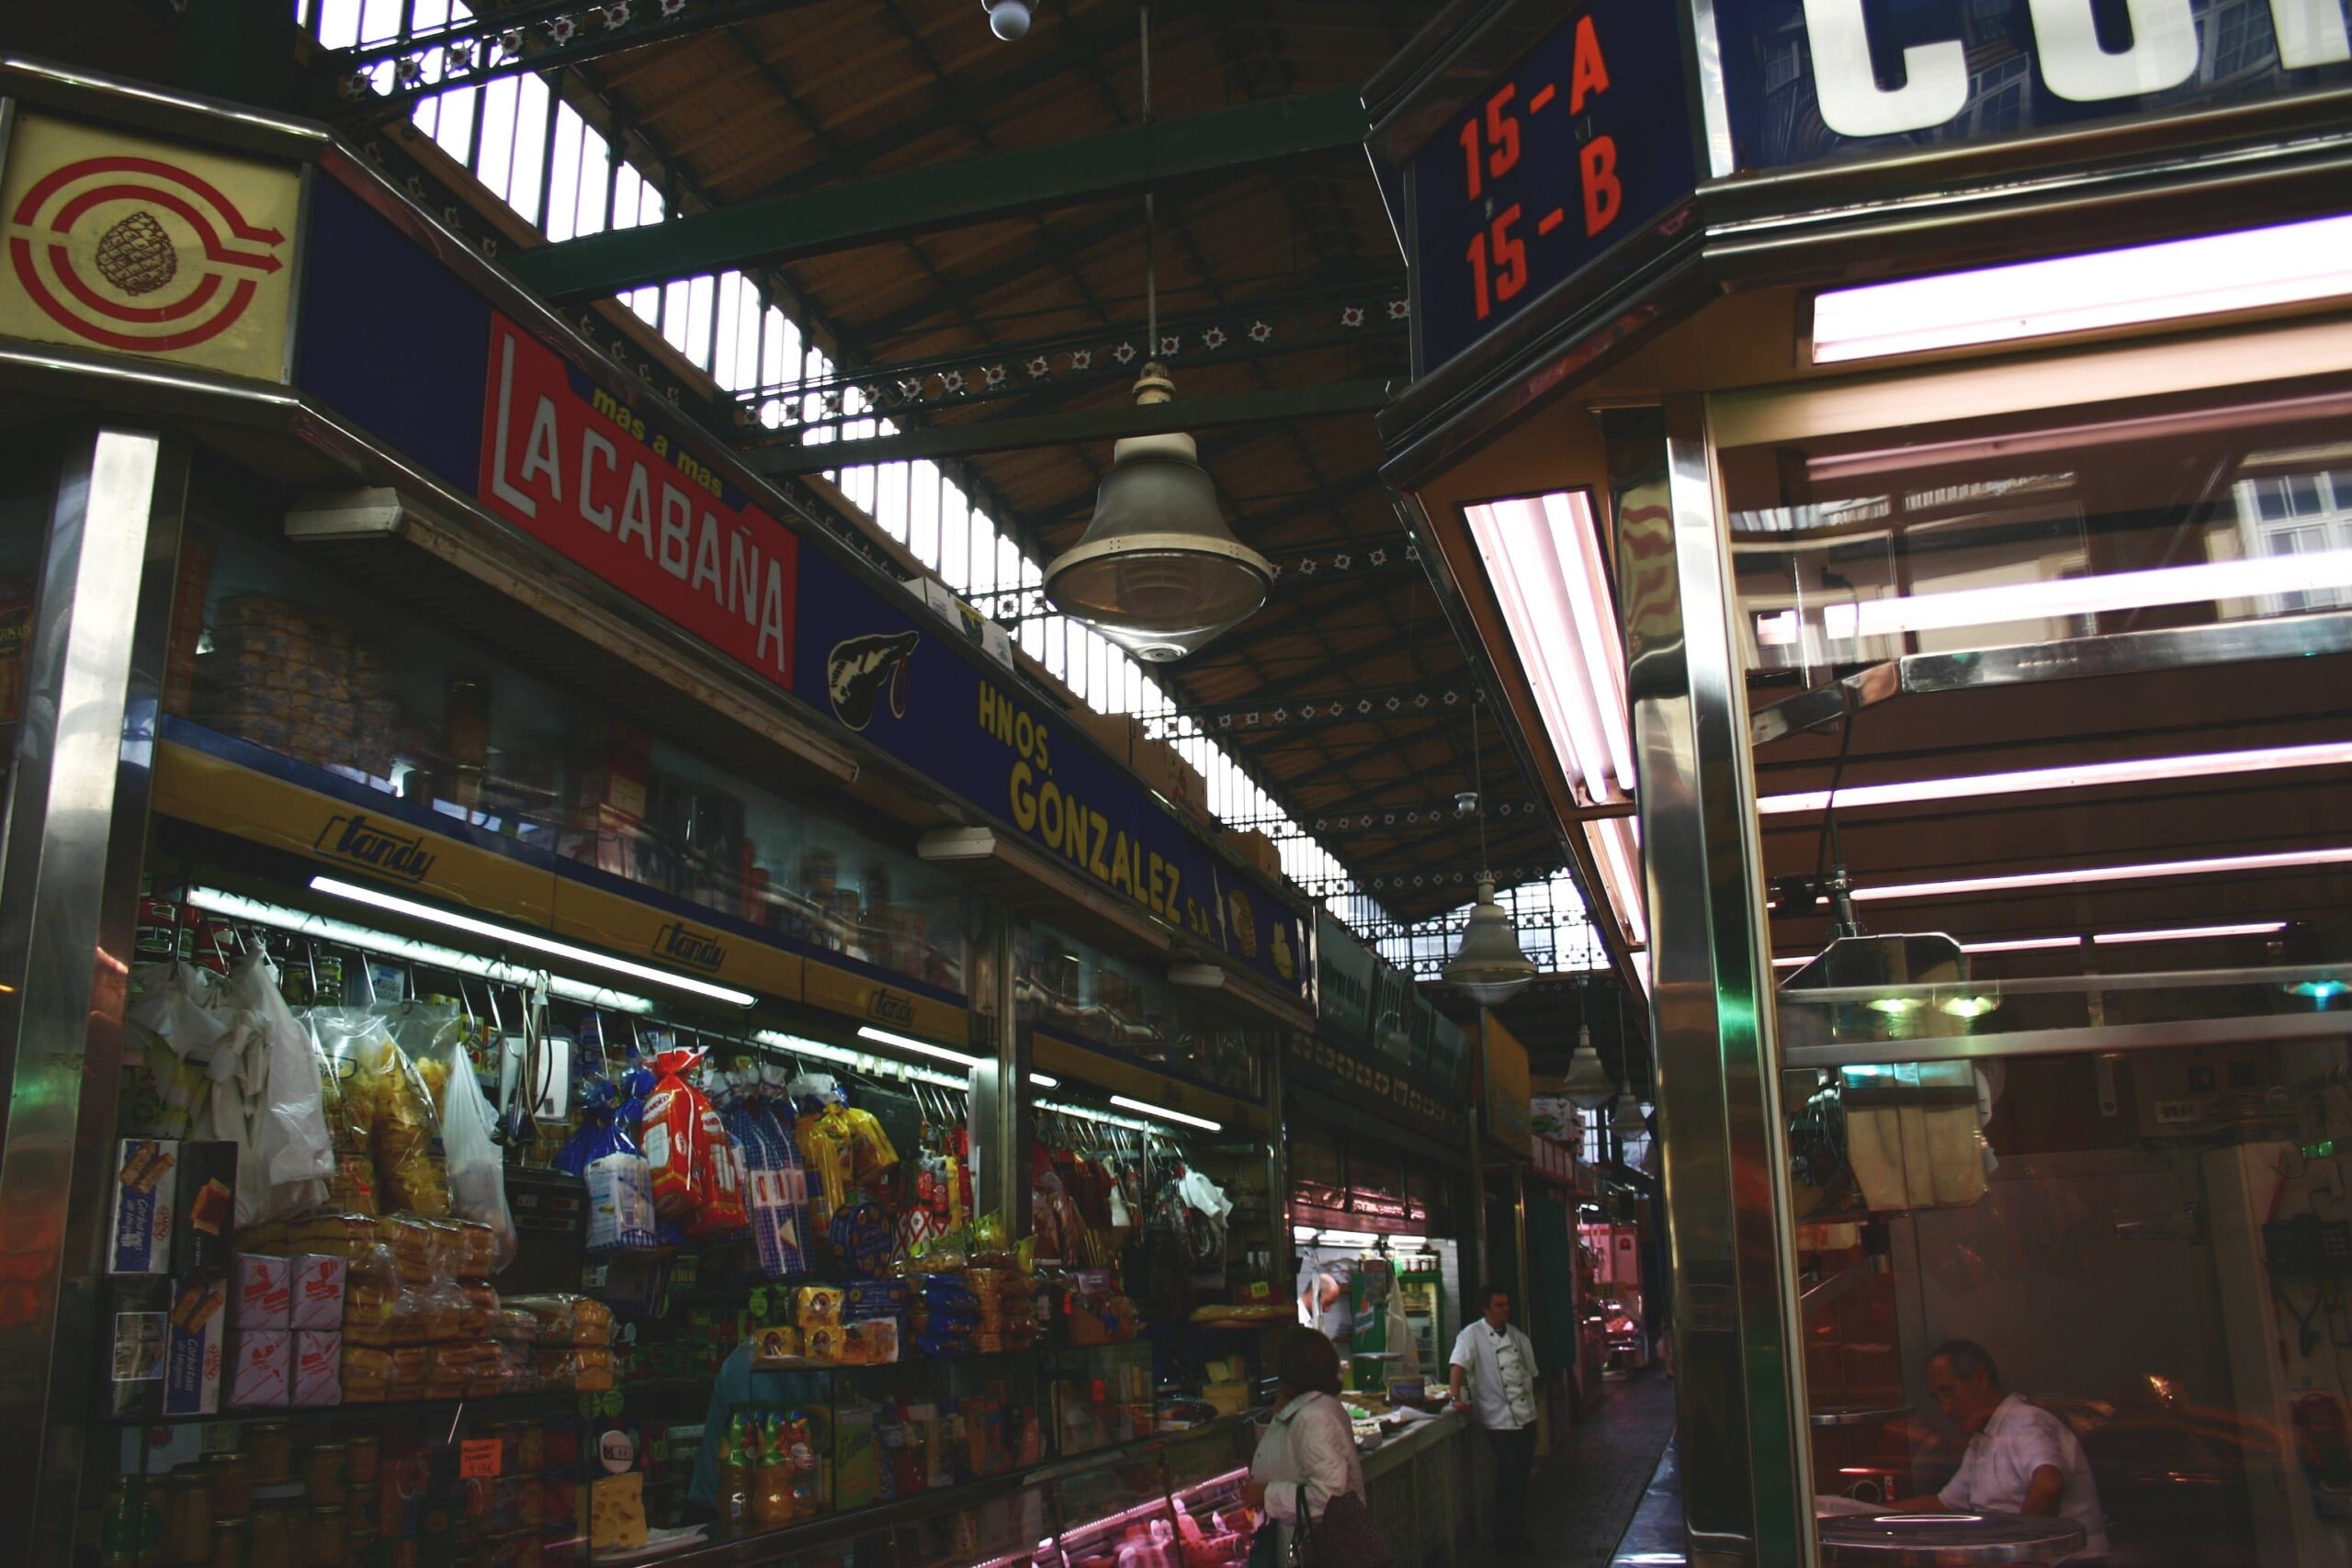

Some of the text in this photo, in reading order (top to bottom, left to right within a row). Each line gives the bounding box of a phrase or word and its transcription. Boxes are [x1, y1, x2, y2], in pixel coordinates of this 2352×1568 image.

[592, 386, 723, 499] mas a mas
[492, 333, 786, 673] LA CABAÑA
[978, 680, 1054, 776] HNOS.
[333, 815, 435, 882] tandy
[1011, 761, 1182, 924] GONZALEZ
[663, 922, 728, 972] tandy
